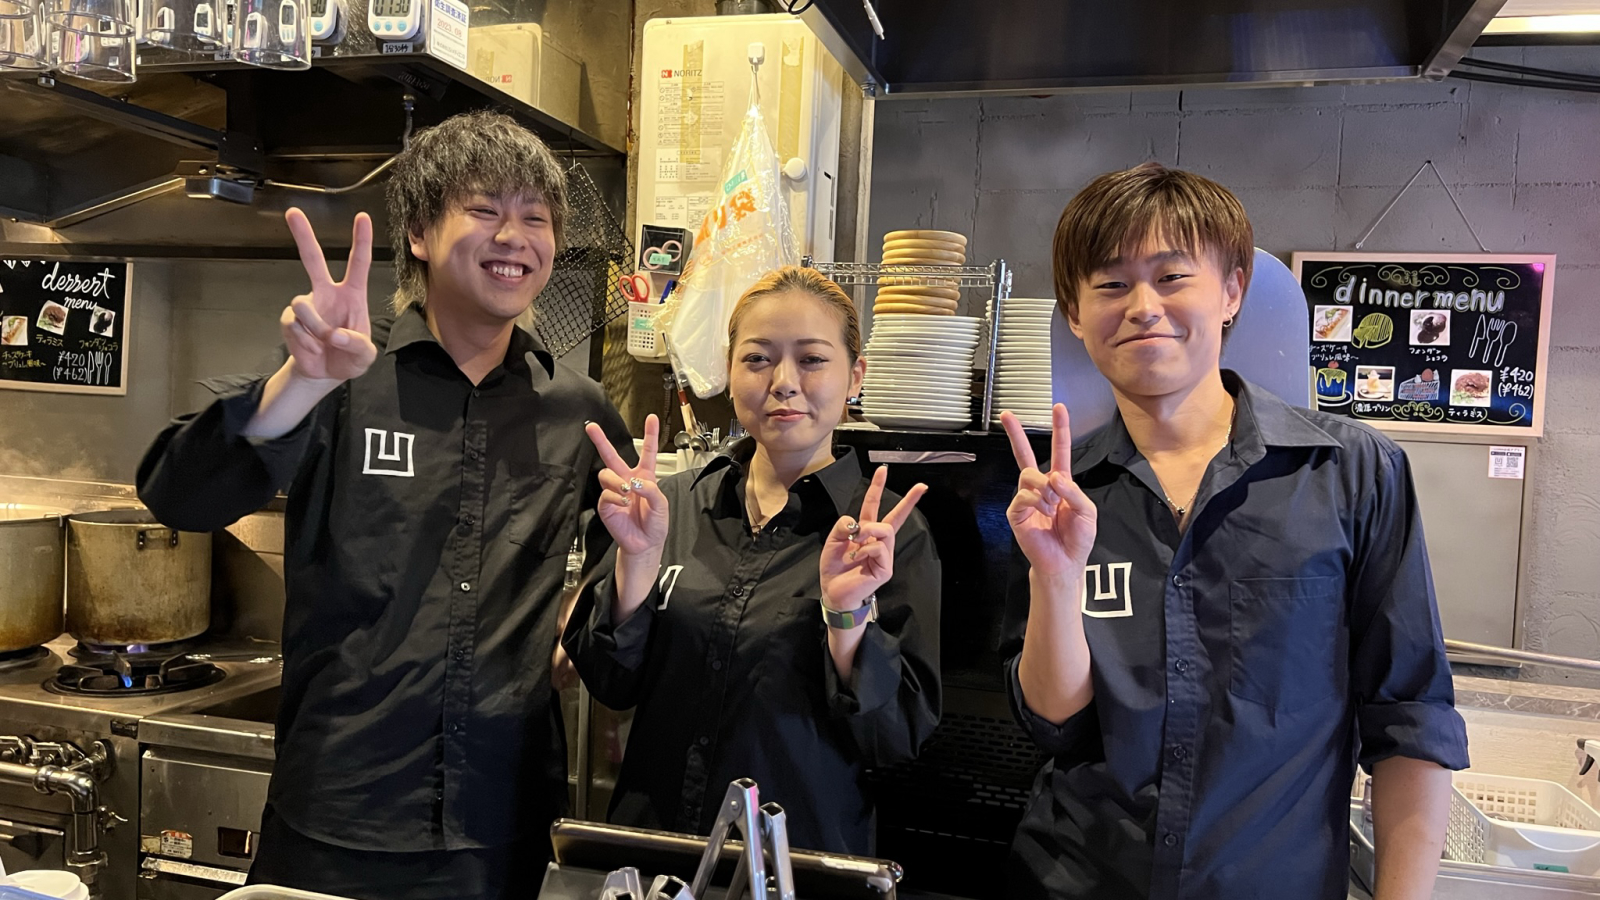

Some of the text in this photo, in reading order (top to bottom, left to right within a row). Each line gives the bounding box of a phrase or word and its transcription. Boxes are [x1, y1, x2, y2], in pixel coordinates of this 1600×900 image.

[673, 69, 702, 77] NORITZ
[41, 261, 115, 299] dessert
[1333, 274, 1505, 314] dinner menu
[64, 296, 98, 310] menu
[35, 334, 63, 347] ティラミス
[1409, 347, 1441, 355] フォンダン
[58, 350, 86, 367] ¥420
[1499, 366, 1534, 383] ¥420
[1497, 382, 1534, 399] (¥462)
[1354, 403, 1391, 413] 濃厚プリン
[1448, 408, 1483, 418] ティラミス
